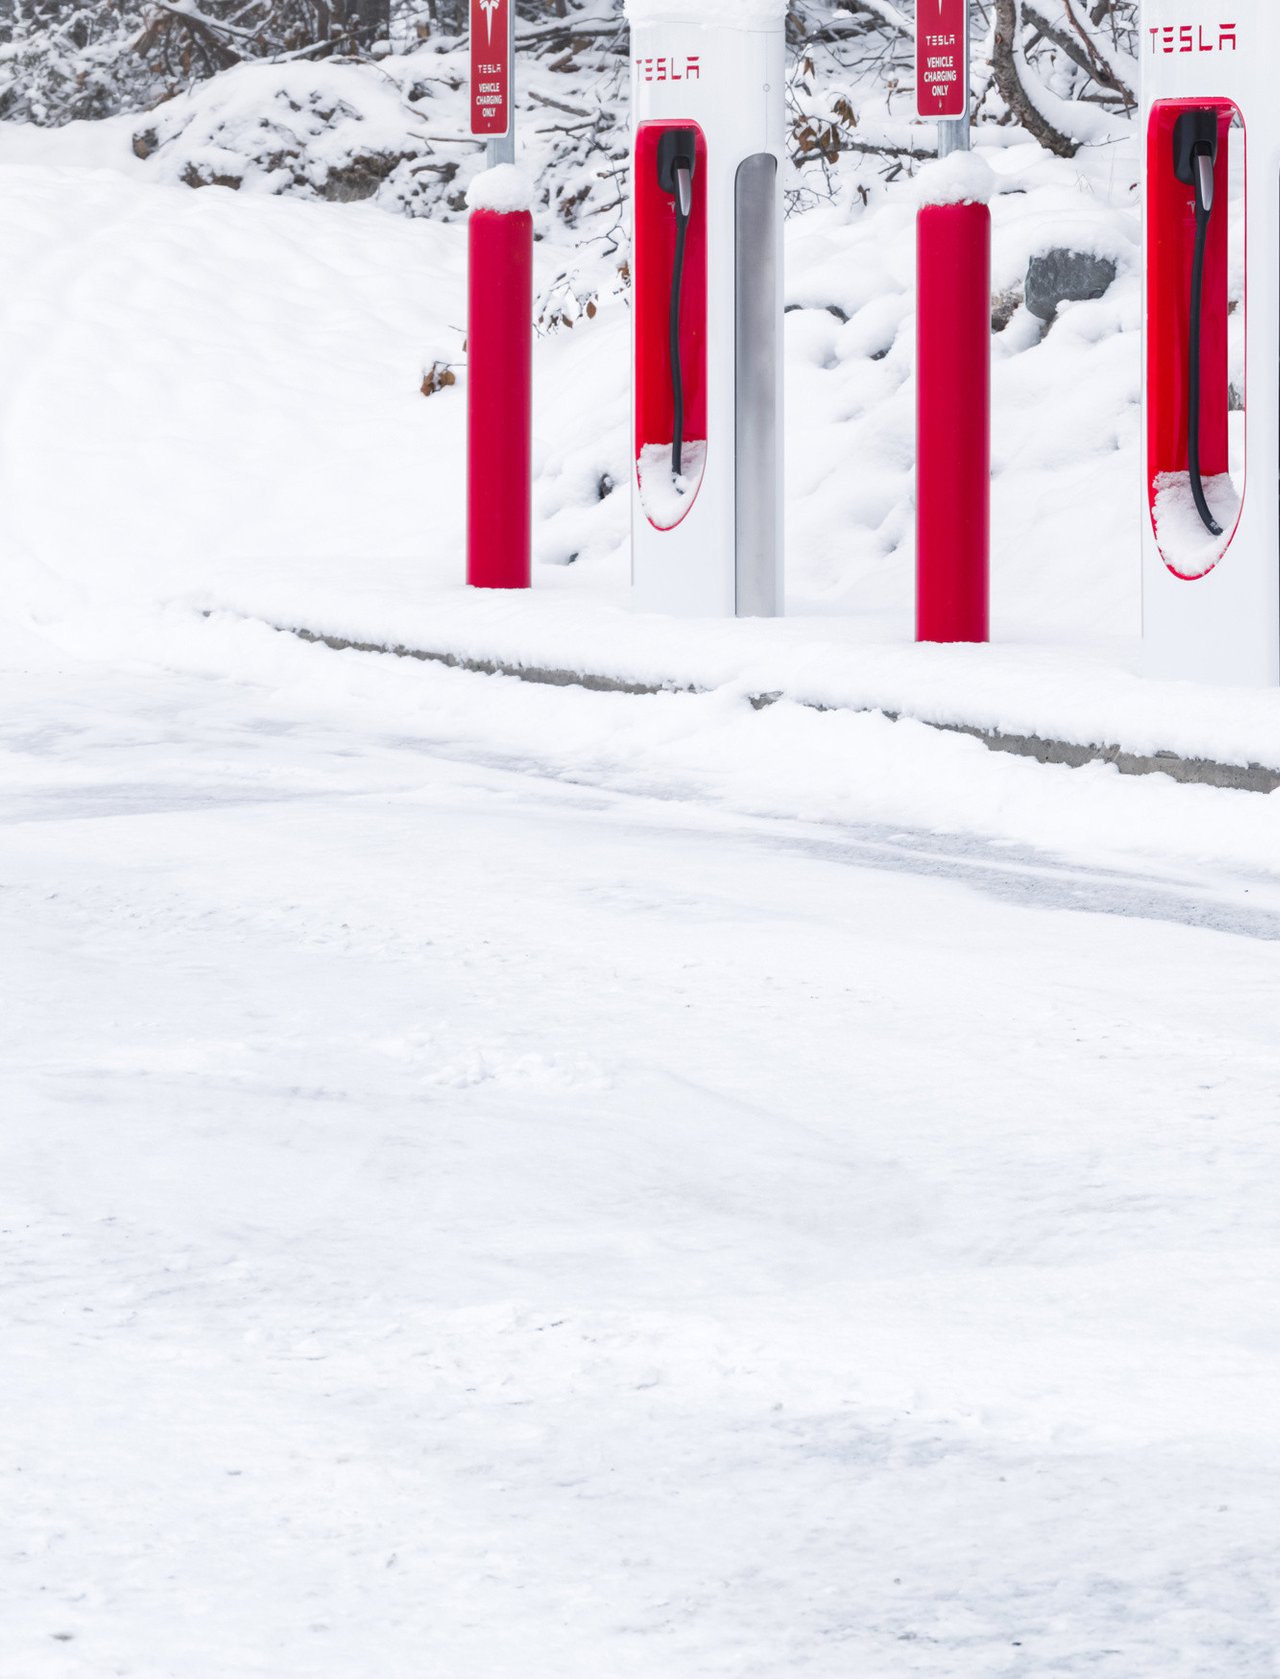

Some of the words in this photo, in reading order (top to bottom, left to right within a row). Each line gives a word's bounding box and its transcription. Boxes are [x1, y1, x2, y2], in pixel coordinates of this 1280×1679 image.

[926, 34, 955, 46] TESLA
[1149, 23, 1237, 53] TESLA
[927, 56, 954, 68] VEHICLE
[478, 63, 501, 74] TESLA
[636, 56, 699, 82] TESLA
[924, 70, 957, 83] CHARGING
[478, 82, 500, 93] VEHICLE
[932, 85, 949, 97] ONLY
[476, 94, 502, 106] CHARGING
[482, 107, 496, 118] ONLY
